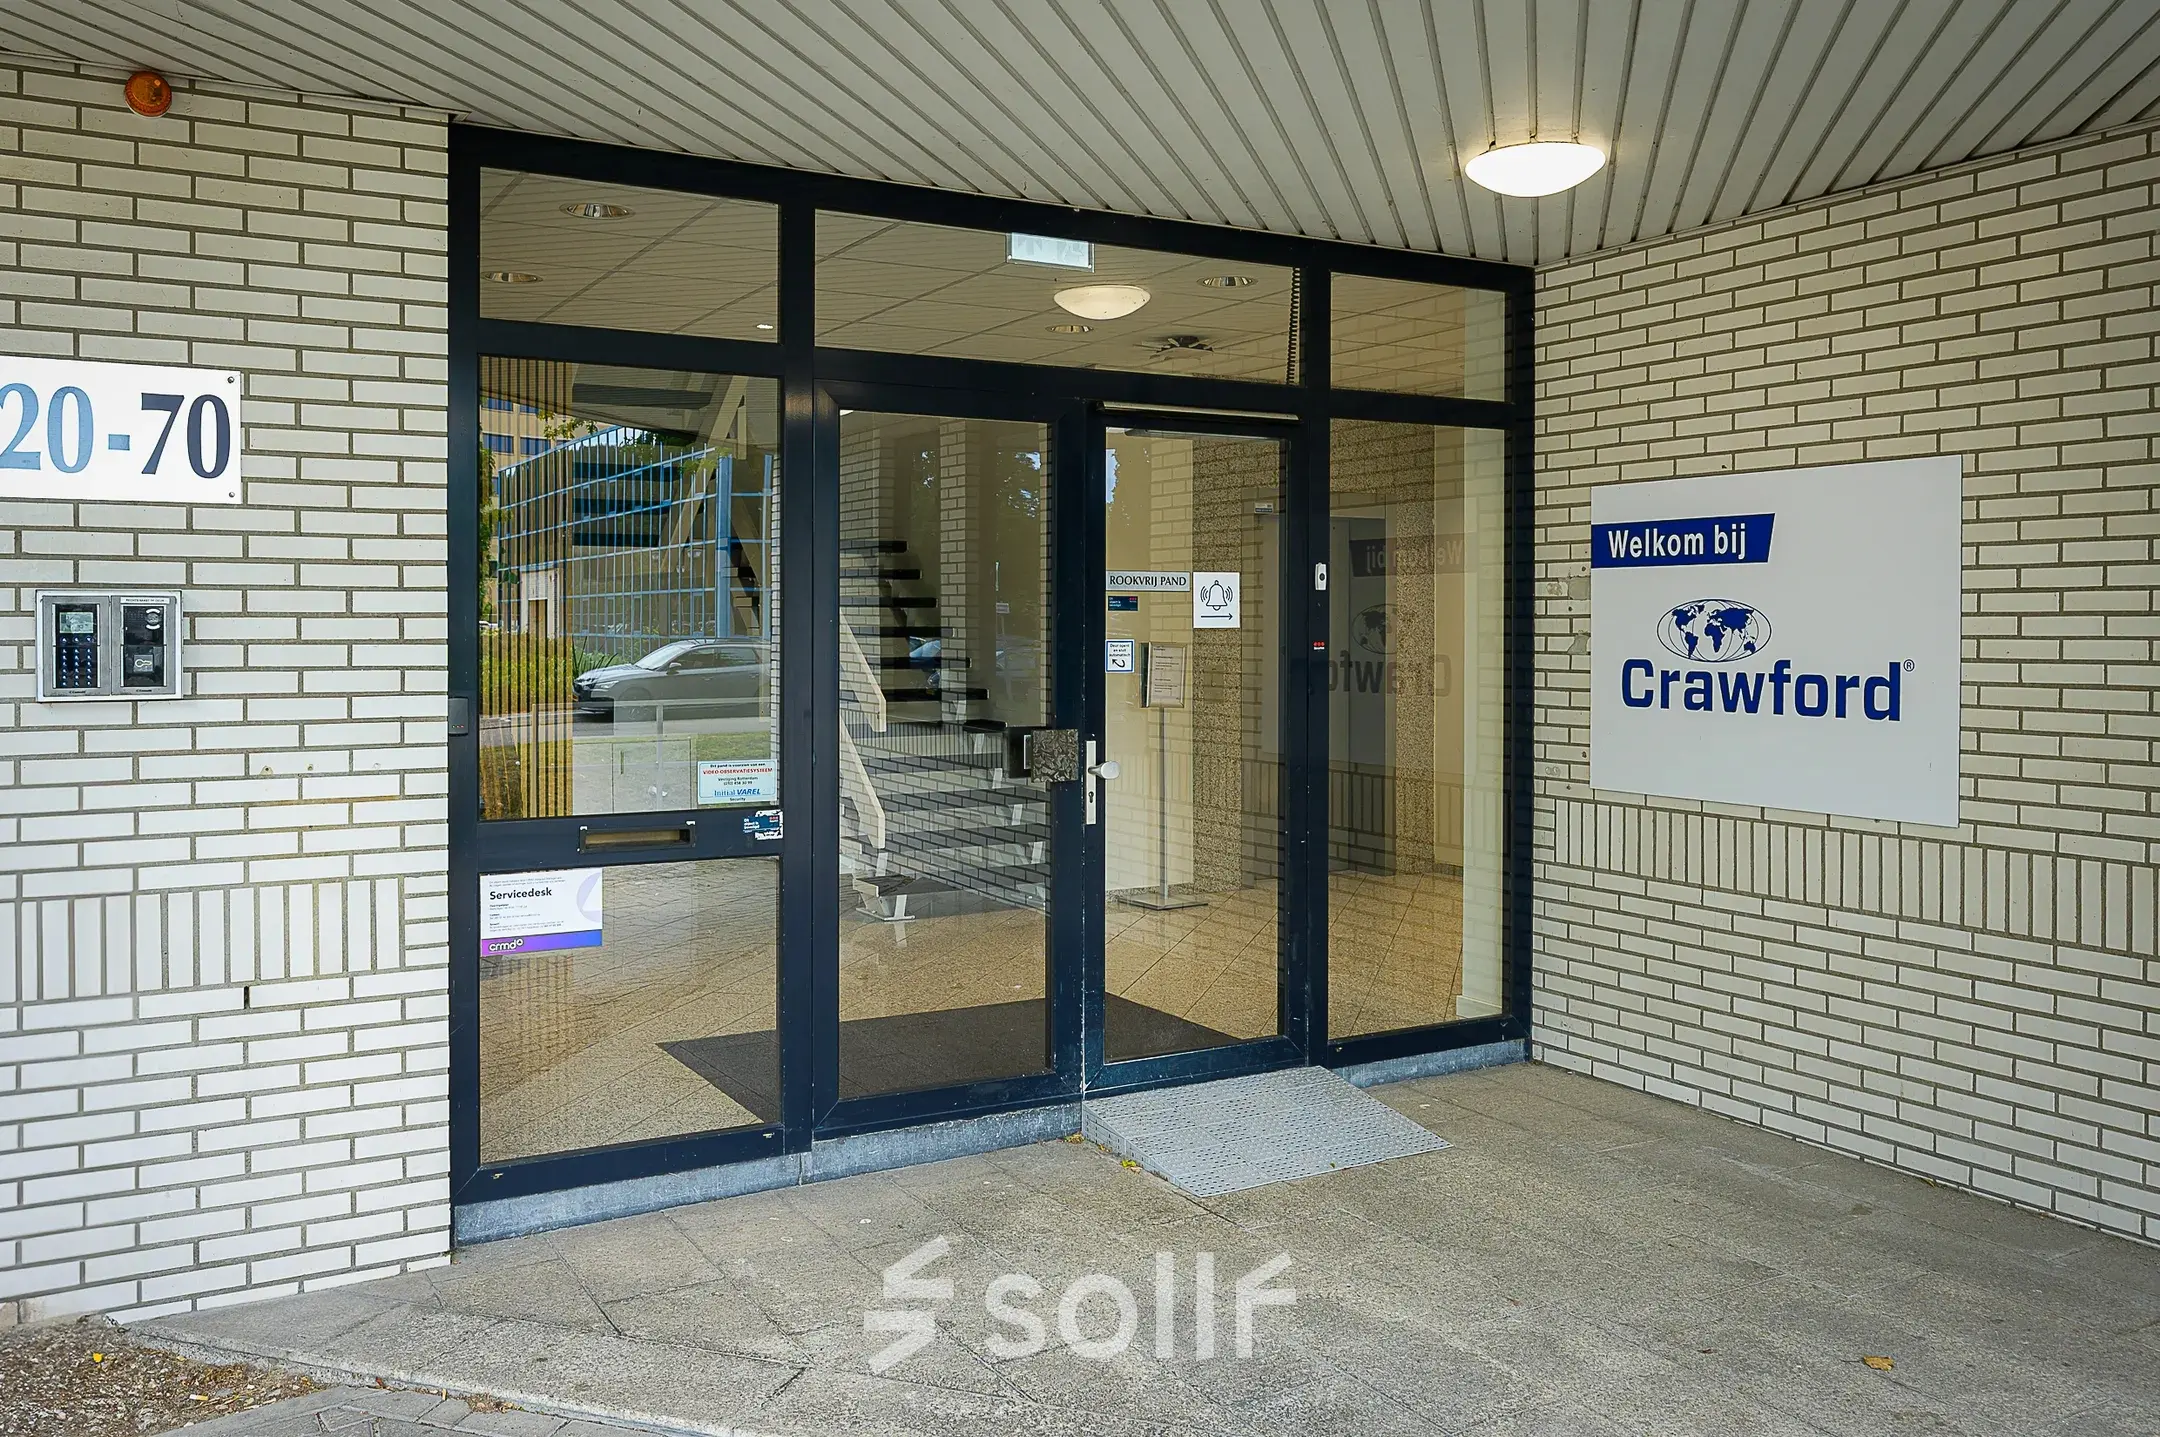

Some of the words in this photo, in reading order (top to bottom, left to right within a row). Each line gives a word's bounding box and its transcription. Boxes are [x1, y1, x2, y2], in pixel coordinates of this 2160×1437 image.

[1608, 526, 1705, 559] Welkom
[1714, 522, 1747, 560] bij
[1109, 575, 1157, 587] ROOKVRIJ
[1160, 576, 1187, 586] PAND
[714, 789, 736, 797] Initial
[736, 788, 761, 796] VAREL
[489, 887, 552, 900] Servicedesk
